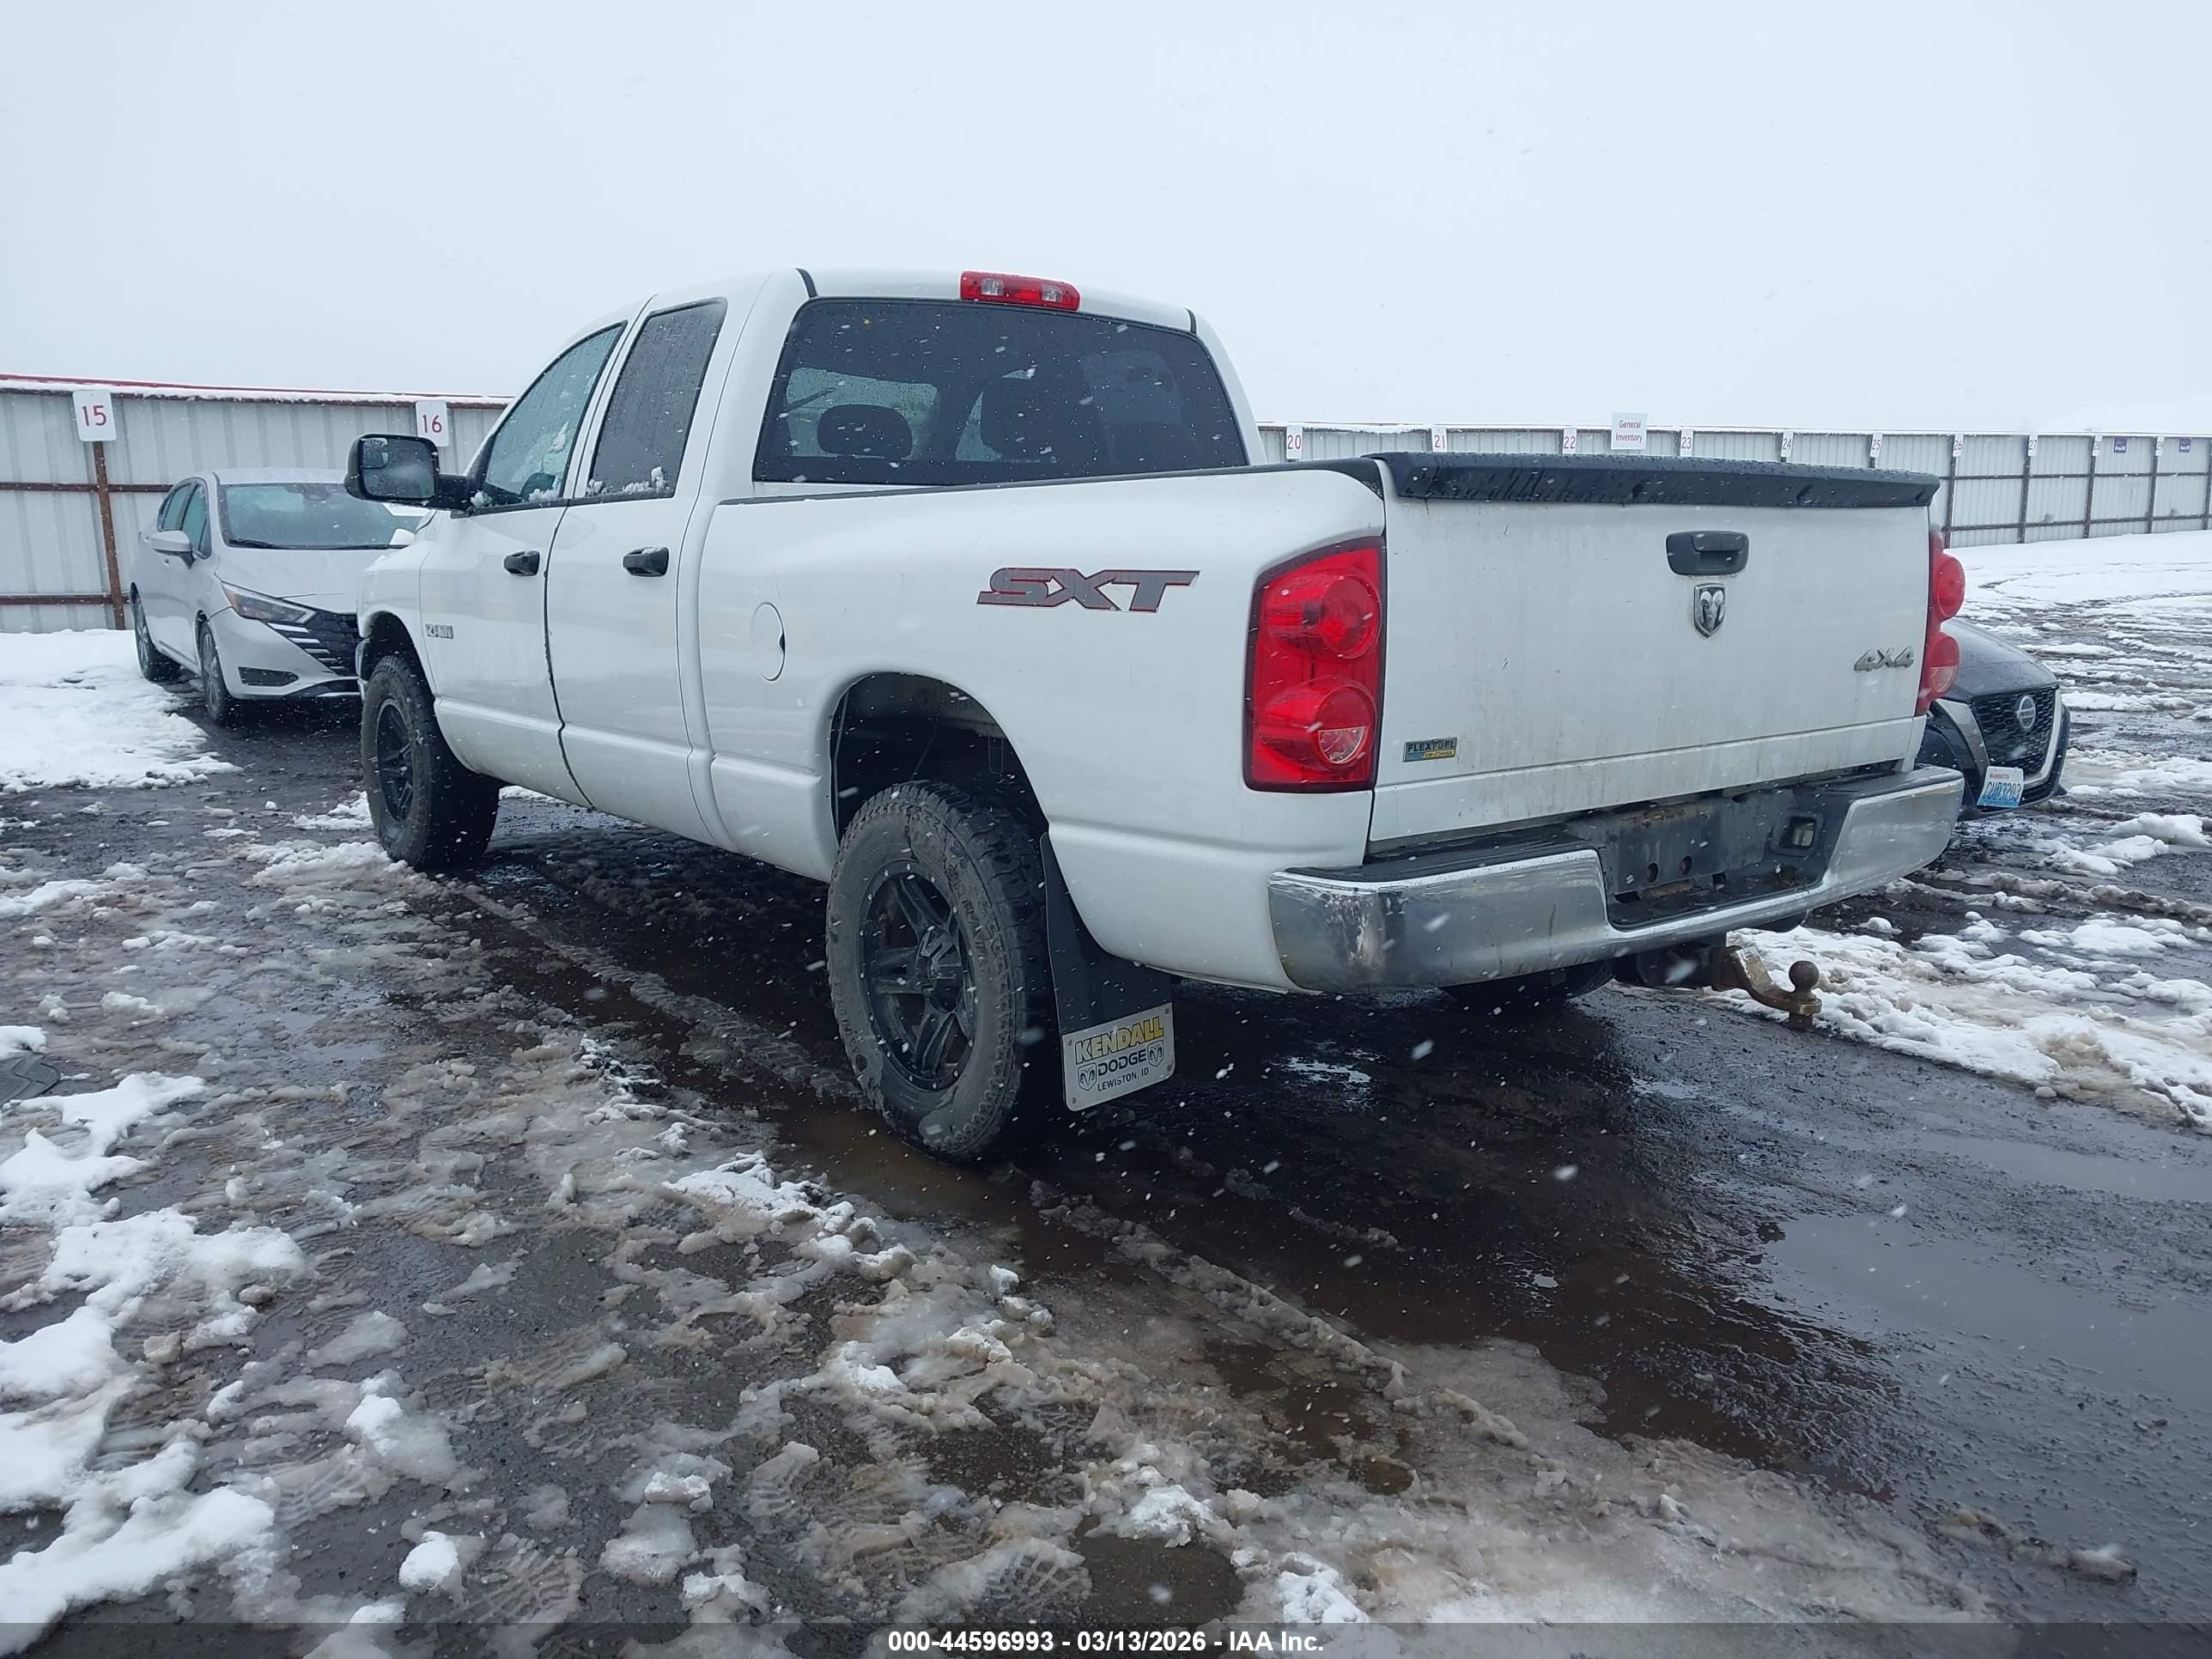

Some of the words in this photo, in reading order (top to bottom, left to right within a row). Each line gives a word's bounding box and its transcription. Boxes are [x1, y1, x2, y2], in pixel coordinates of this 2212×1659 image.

[82, 404, 106, 427] 15
[422, 414, 442, 434] 16
[1619, 420, 1642, 429] General
[1287, 434, 1302, 450] 20
[1434, 434, 1446, 448] 21
[1564, 436, 1576, 449] 22
[1615, 433, 1643, 443] Inventory
[1681, 436, 1692, 449] 23
[1783, 439, 1792, 450] 24
[1872, 440, 1881, 451] 25
[1954, 440, 1962, 451] 26
[2029, 440, 2038, 451] 27
[976, 568, 1200, 613] SXT
[1074, 1016, 1164, 1066] KENDALL
[1097, 1048, 1147, 1077] DODGE
[1097, 1073, 1139, 1092] LEWISTON,
[1141, 1066, 1149, 1077] ID
